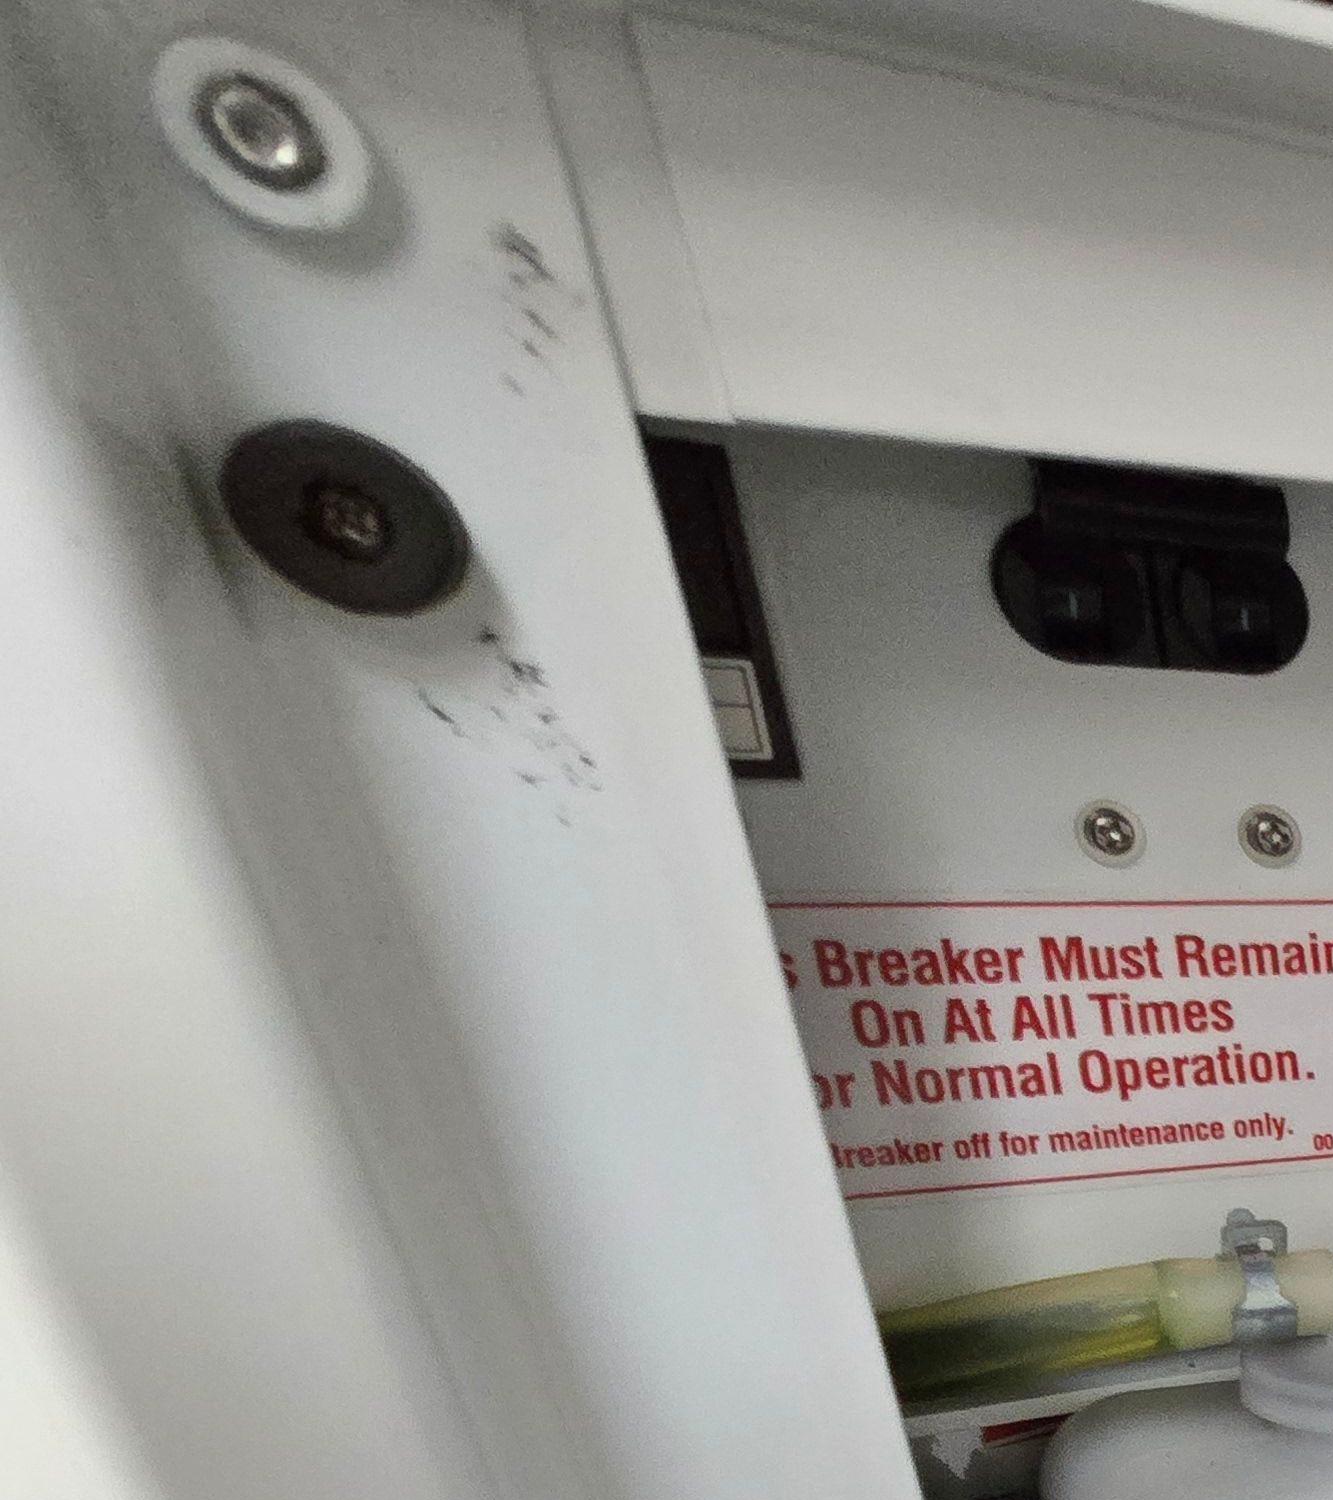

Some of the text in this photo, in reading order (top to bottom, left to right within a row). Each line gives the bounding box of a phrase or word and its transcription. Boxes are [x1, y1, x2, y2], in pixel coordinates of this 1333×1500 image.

[813, 938, 1024, 989] Breaker
[1039, 935, 1164, 983] Must
[850, 992, 1236, 1049] On At All Times
[869, 1051, 1063, 1107] Normal
[1077, 1043, 1317, 1102] Operation.
[953, 1130, 992, 1162] off
[999, 1130, 1041, 1158] for
[1048, 1116, 1226, 1154] maintenance
[1233, 1111, 1295, 1142] only.
